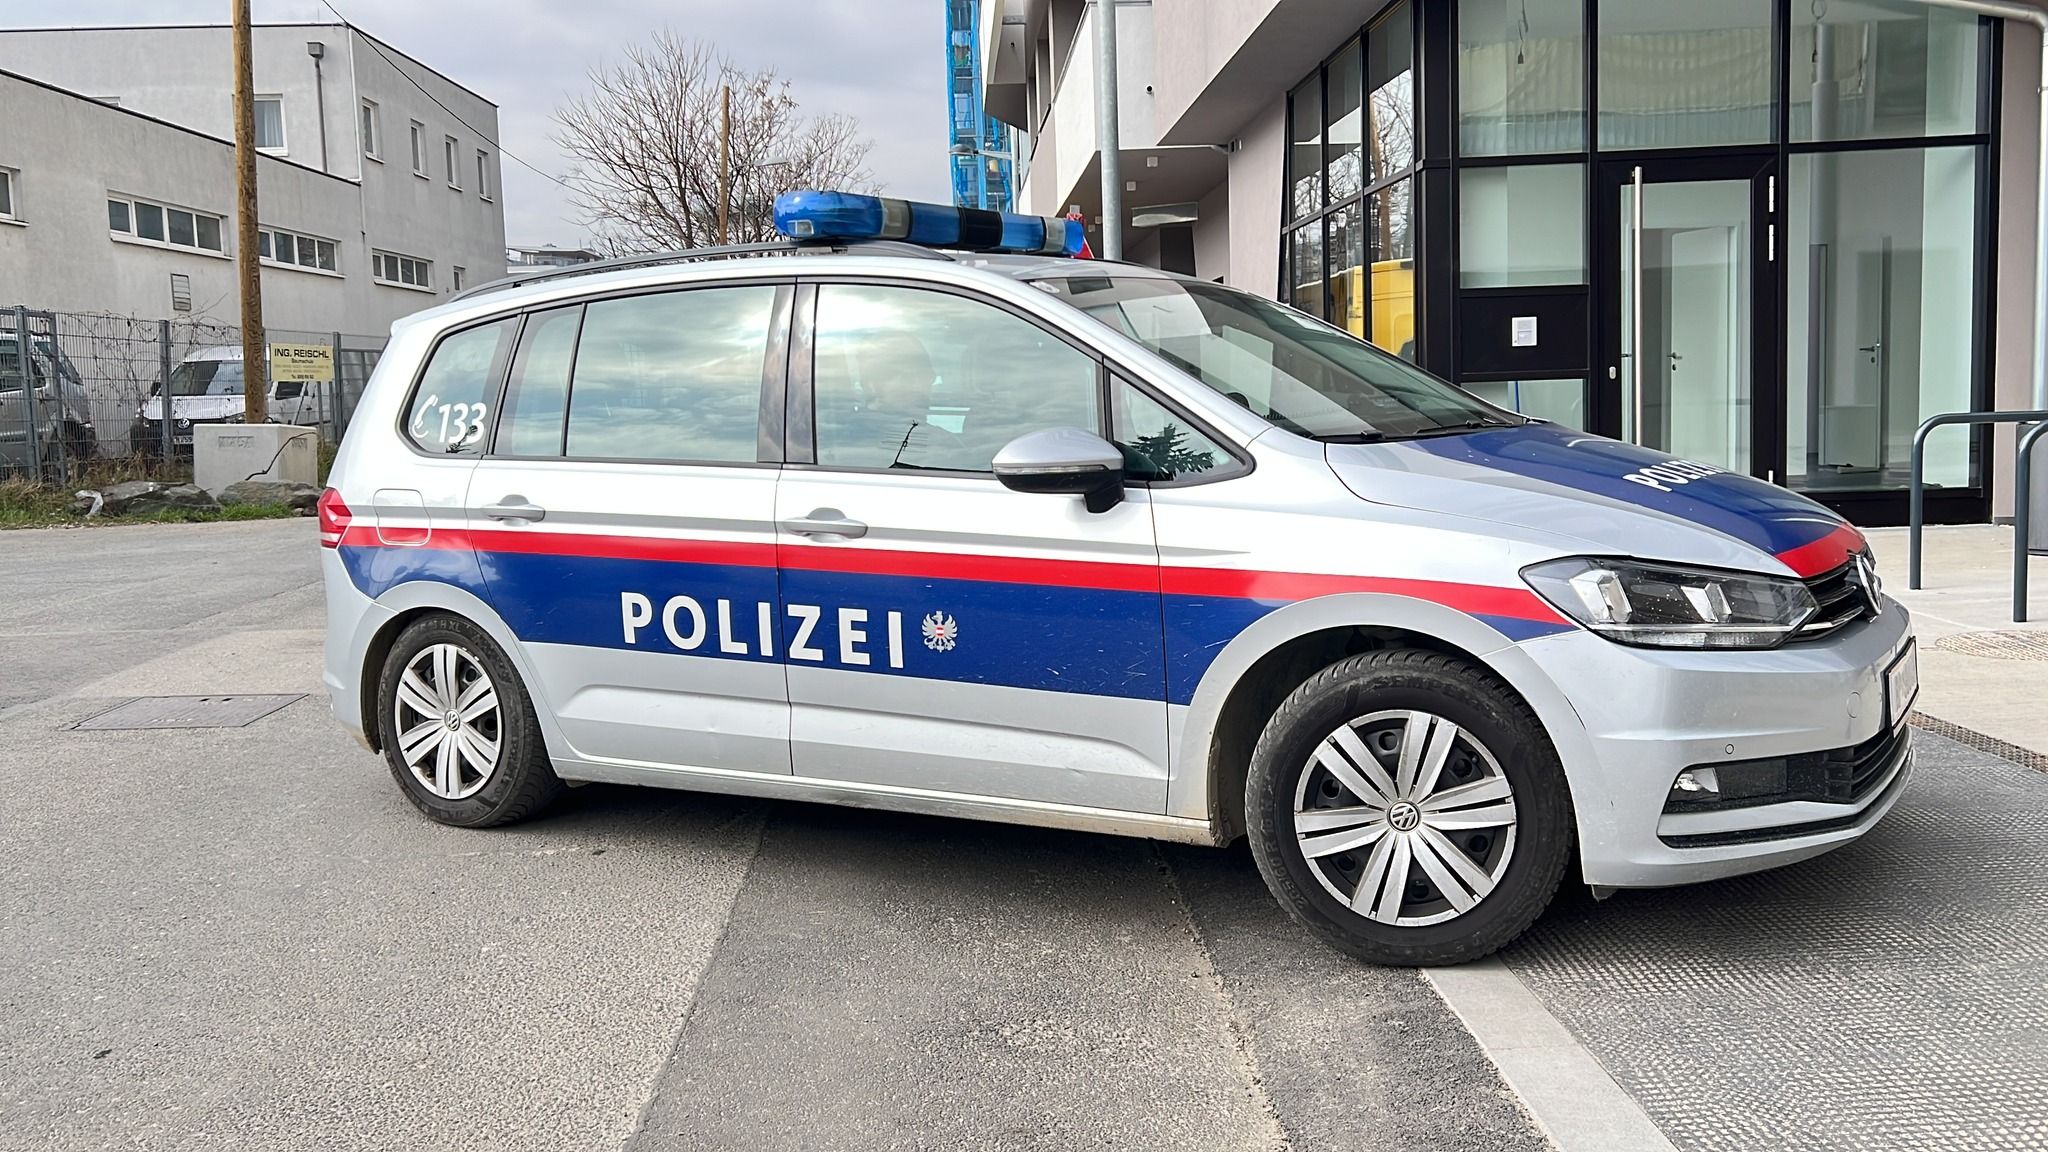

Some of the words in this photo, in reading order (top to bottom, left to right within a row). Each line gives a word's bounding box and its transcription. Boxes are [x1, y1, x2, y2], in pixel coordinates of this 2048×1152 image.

[274, 348, 292, 357] ING.
[293, 349, 330, 359] REISCHL
[438, 402, 487, 444] 133
[621, 591, 904, 668] POLIZEI
